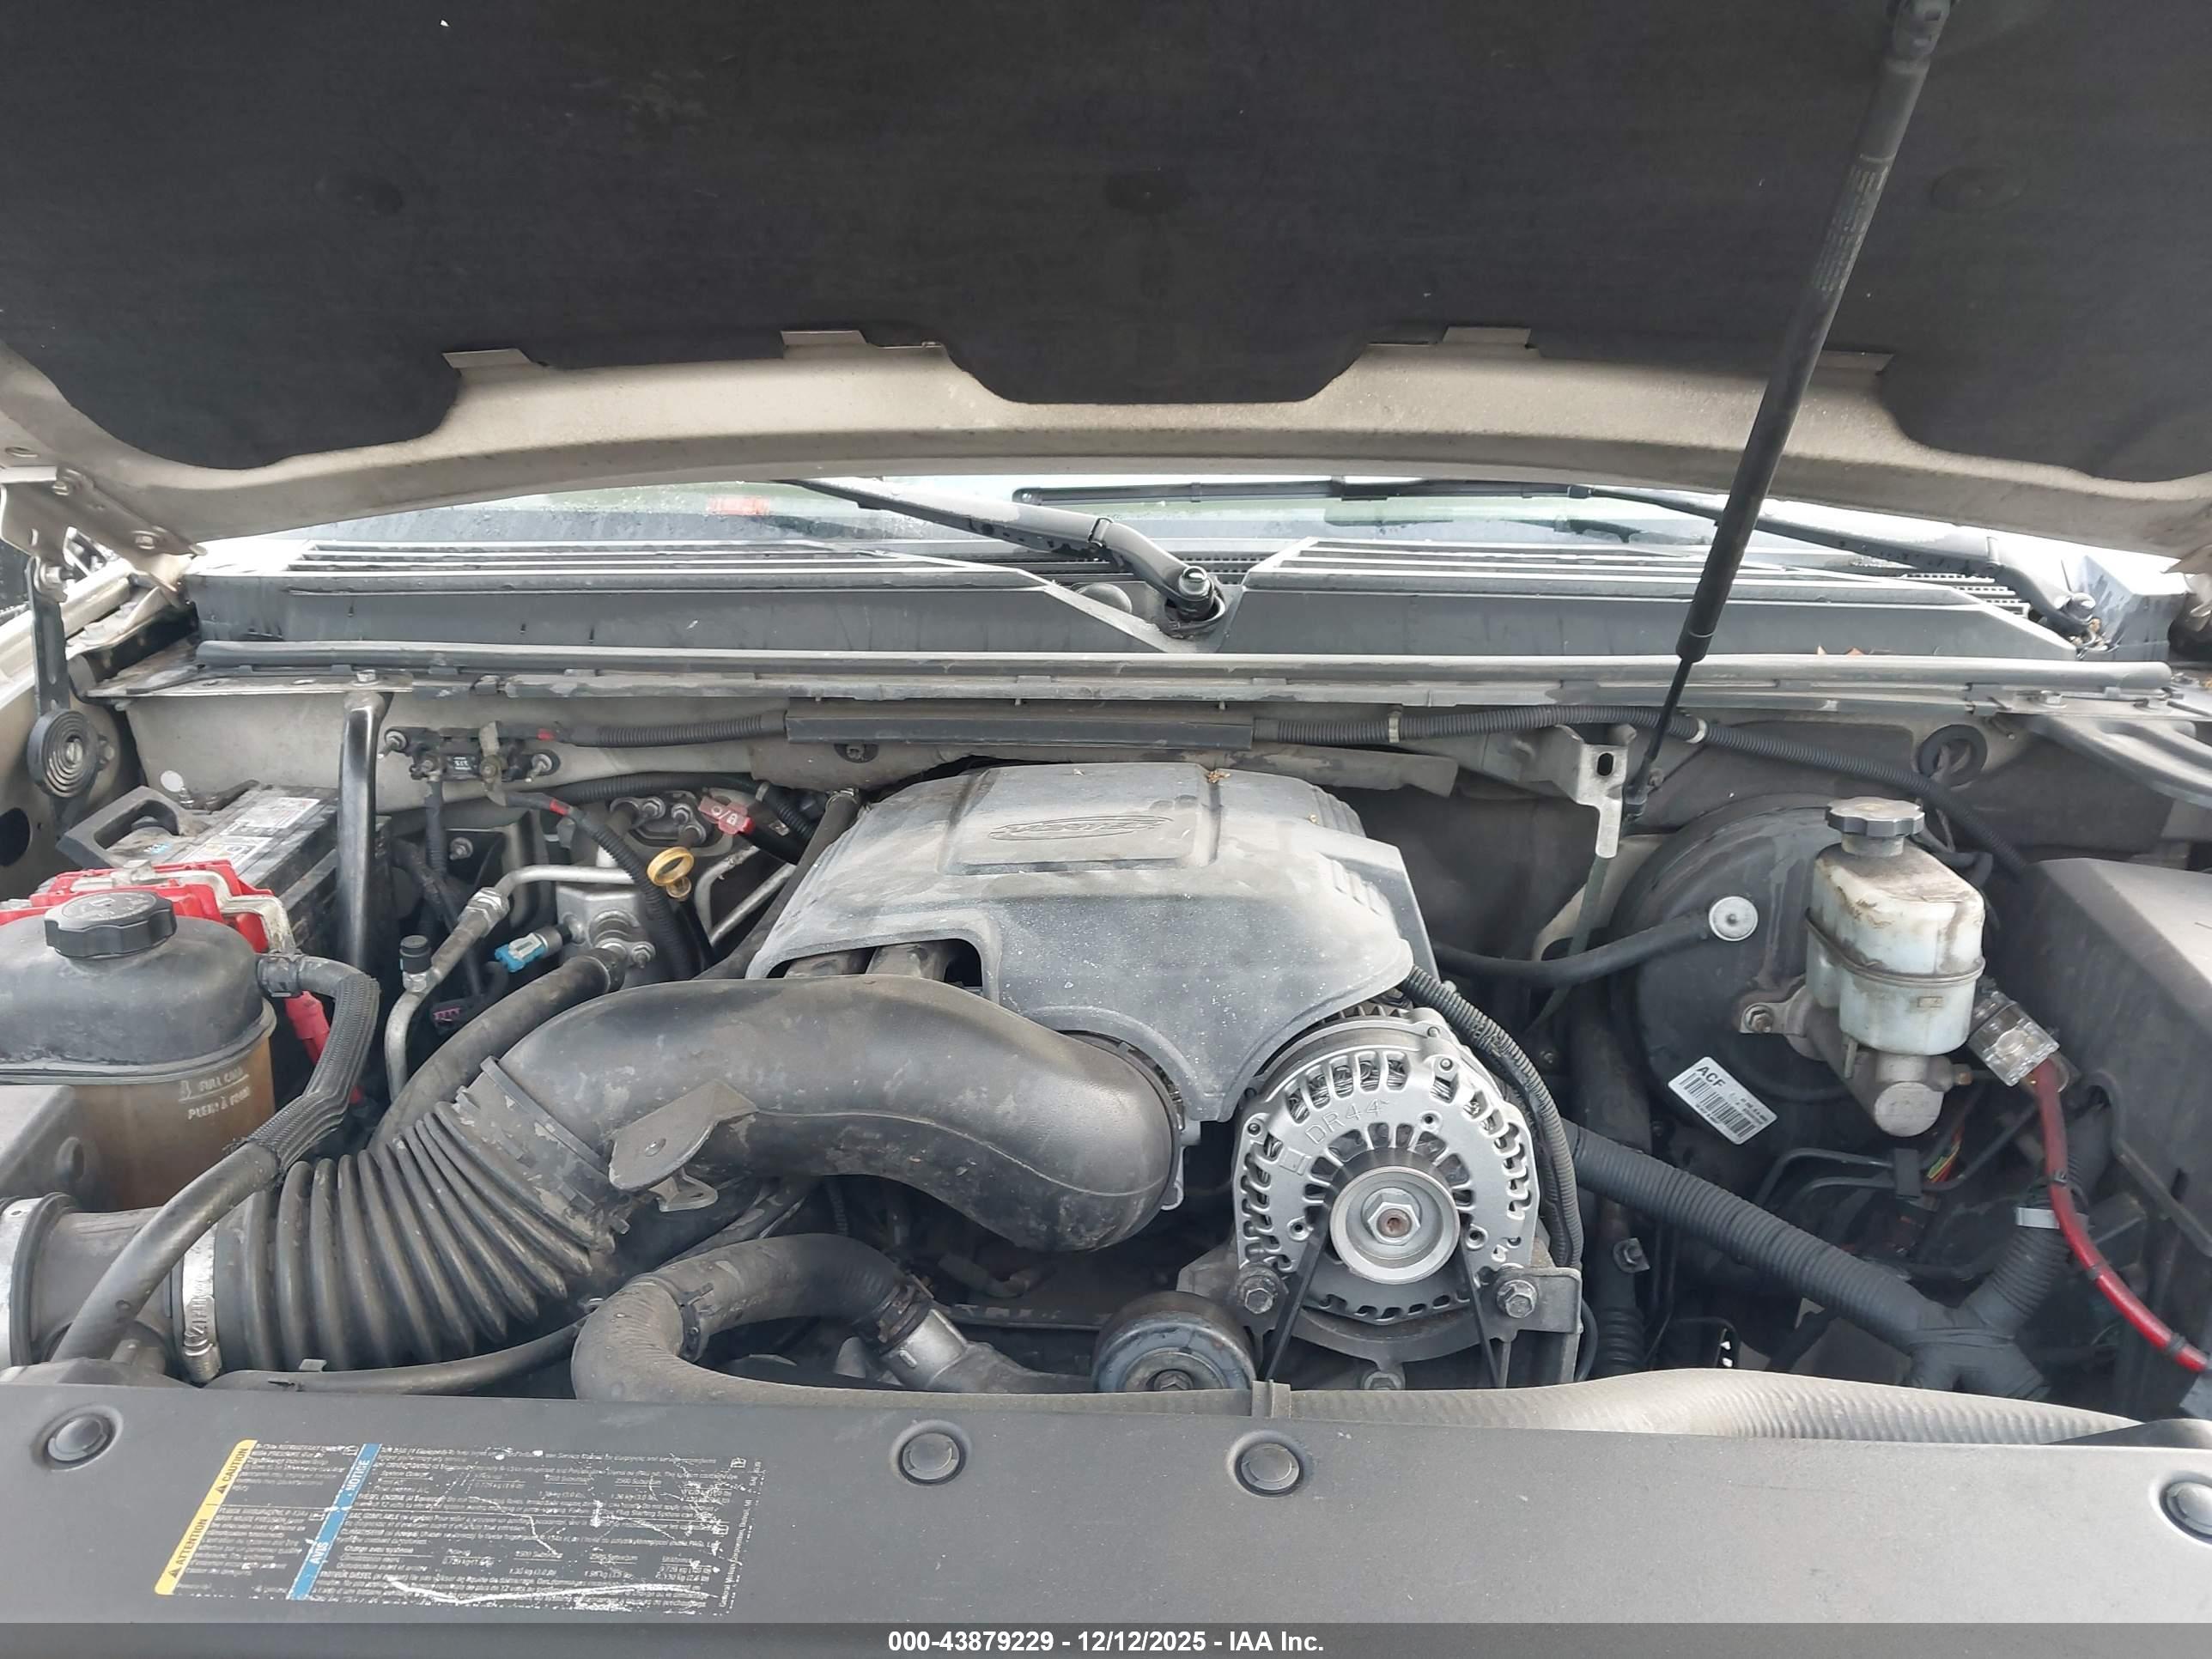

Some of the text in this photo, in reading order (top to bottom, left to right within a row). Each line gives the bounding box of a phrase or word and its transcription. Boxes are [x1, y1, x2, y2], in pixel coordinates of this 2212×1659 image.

[1696, 1066, 1726, 1088] ACF
[1305, 1098, 1382, 1145] DR44
[222, 1448, 249, 1482] CAUTION
[344, 1459, 372, 1492] NOTICE
[176, 1518, 209, 1565] ATTENTION
[308, 1540, 331, 1565] AVIS
